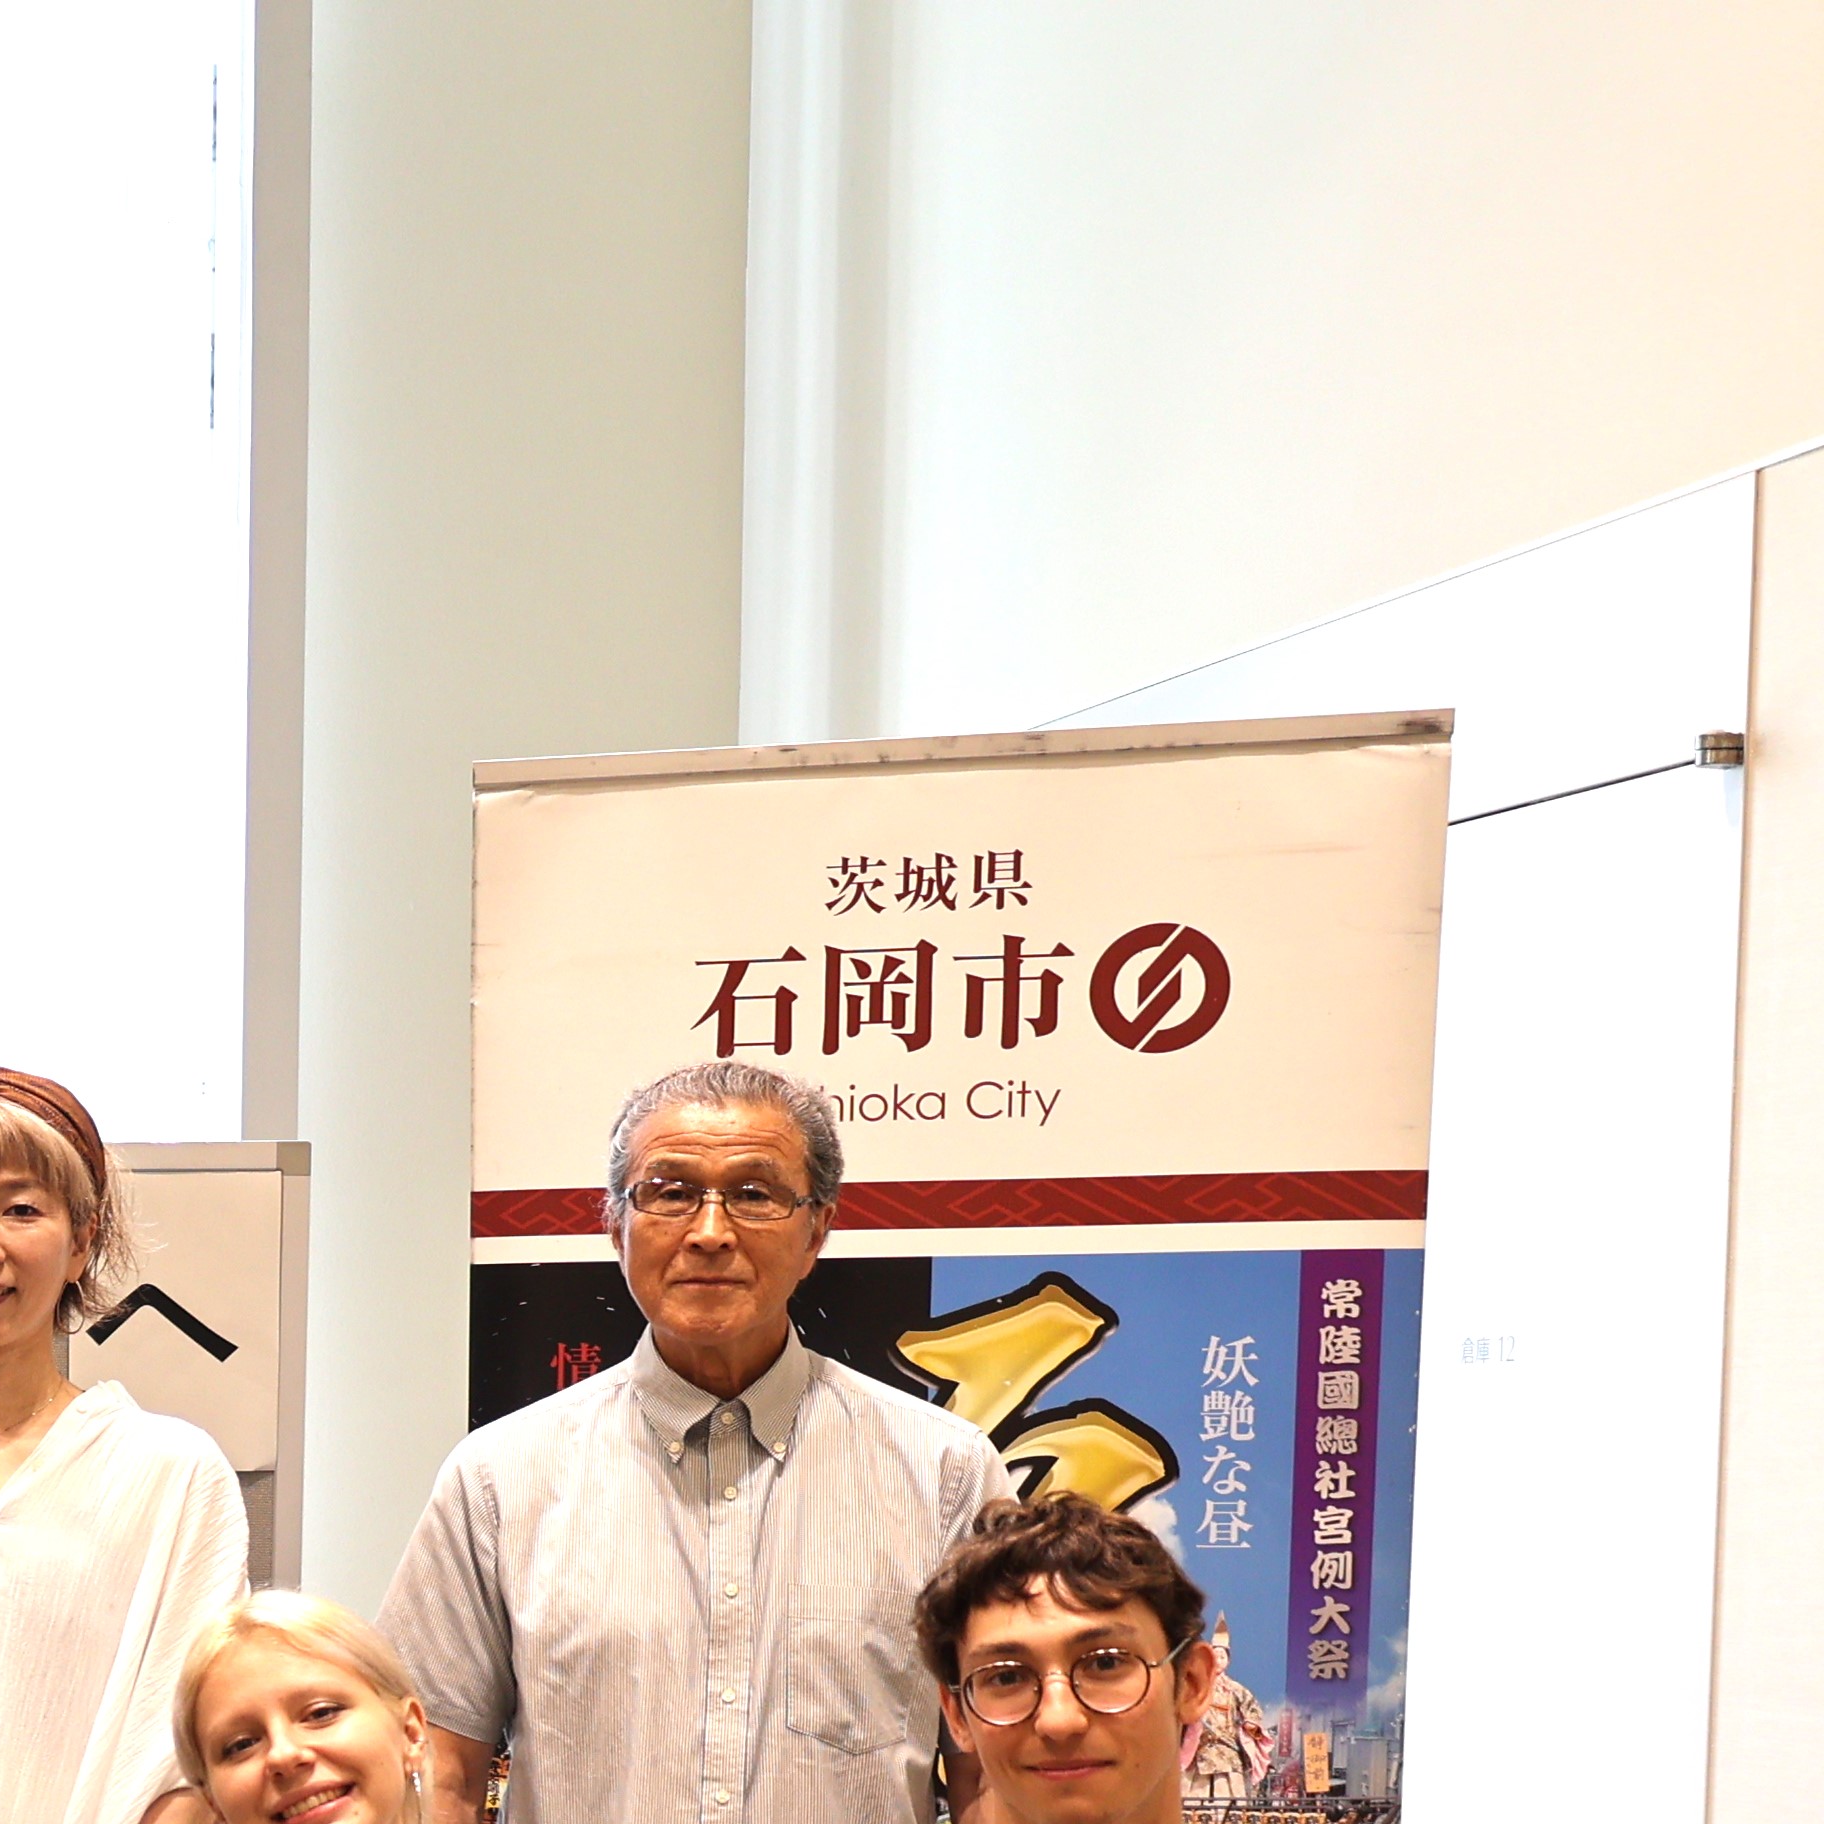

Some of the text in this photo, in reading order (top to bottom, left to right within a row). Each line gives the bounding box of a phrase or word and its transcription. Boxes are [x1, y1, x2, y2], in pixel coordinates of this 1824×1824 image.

[824, 848, 1033, 917] 茨城県
[690, 934, 1076, 1058] 石岡市
[966, 1080, 1062, 1127] City
[1499, 1335, 1515, 1362] 12
[1196, 1335, 1260, 1549] 妖艶な昼
